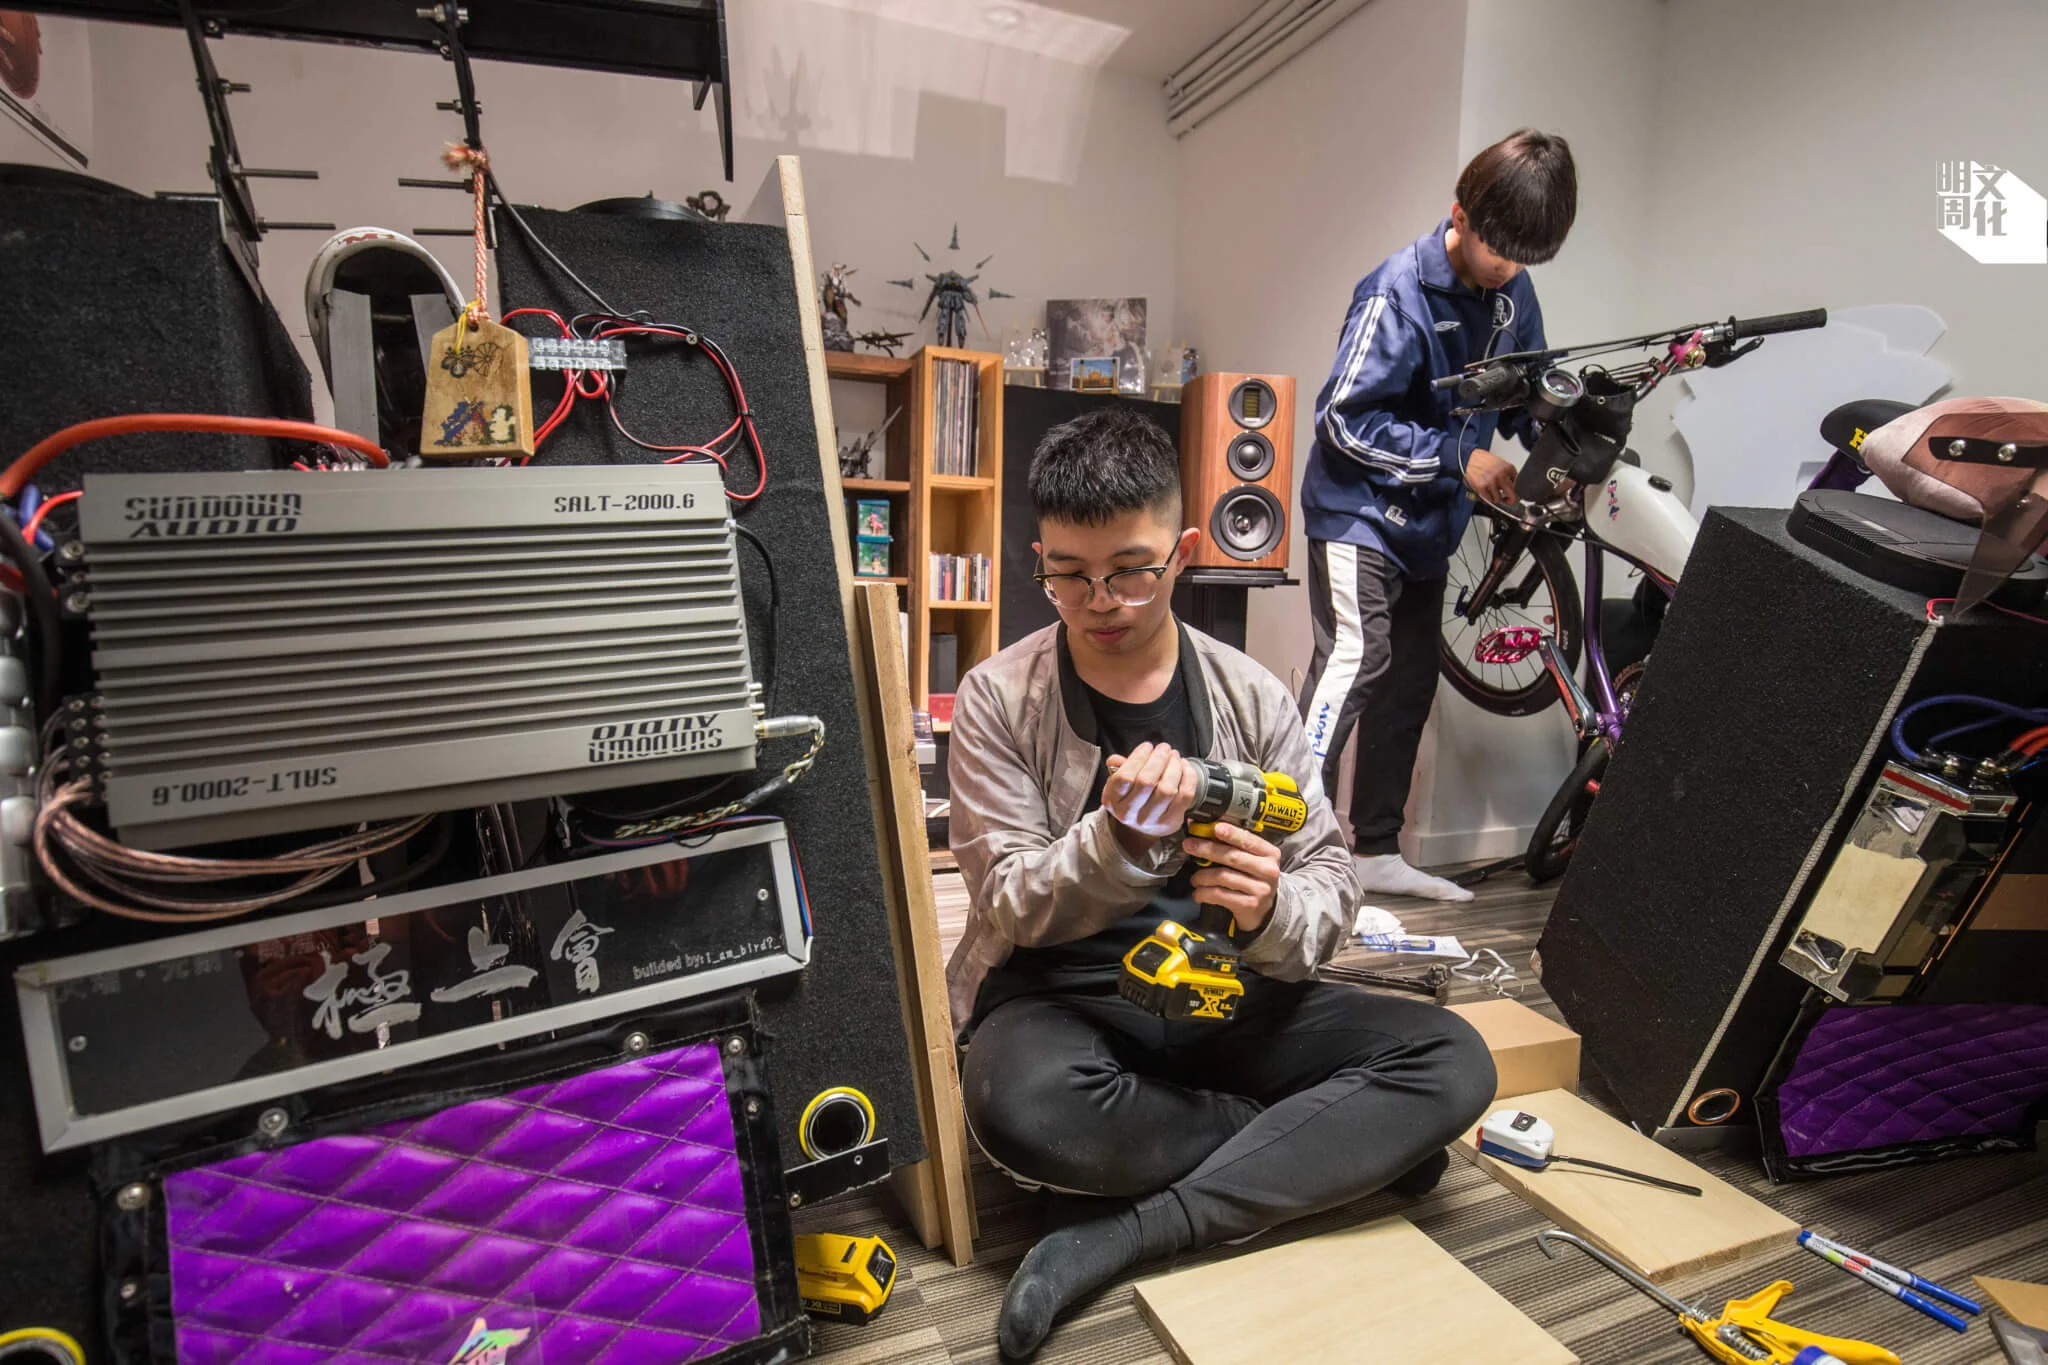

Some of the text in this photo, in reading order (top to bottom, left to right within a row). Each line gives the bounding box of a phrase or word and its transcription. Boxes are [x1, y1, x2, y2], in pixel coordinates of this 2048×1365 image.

[553, 492, 696, 514] SALT-2000.6
[129, 517, 298, 539] AUDIO
[591, 713, 721, 741] AUDIO
[151, 766, 338, 807] SALT-2000.6
[632, 954, 682, 981] builded
